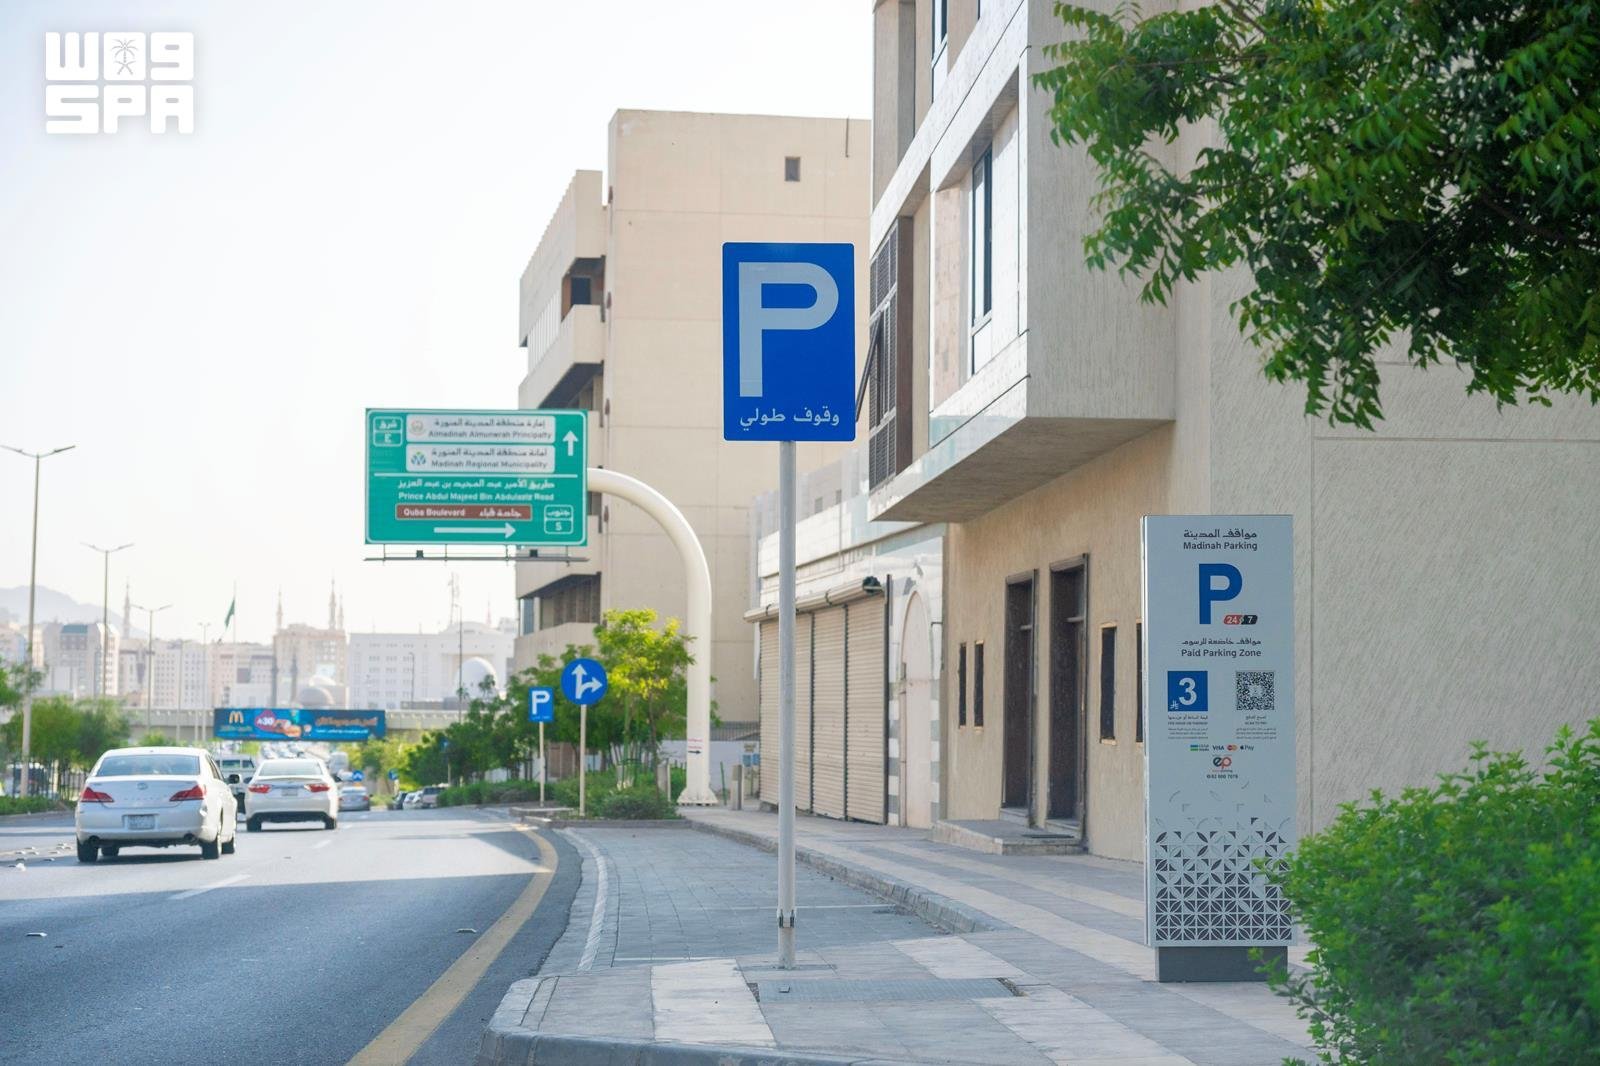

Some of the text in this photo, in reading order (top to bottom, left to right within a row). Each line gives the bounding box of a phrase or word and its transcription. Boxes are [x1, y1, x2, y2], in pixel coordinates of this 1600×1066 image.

[738, 262, 840, 398] P
[739, 405, 840, 431] وقوف طولي
[431, 460, 464, 468] Madinah
[398, 491, 425, 500] Prince
[425, 491, 449, 500] Abdul
[403, 507, 466, 517] Quba Boulevard
[1183, 527, 1257, 540] مواقف المدينة
[1183, 541, 1258, 552] Madinah Parking
[1198, 563, 1243, 625] P
[1181, 648, 1262, 659] Paid Parking Zone
[1178, 677, 1198, 706] 3
[531, 690, 551, 715] P
